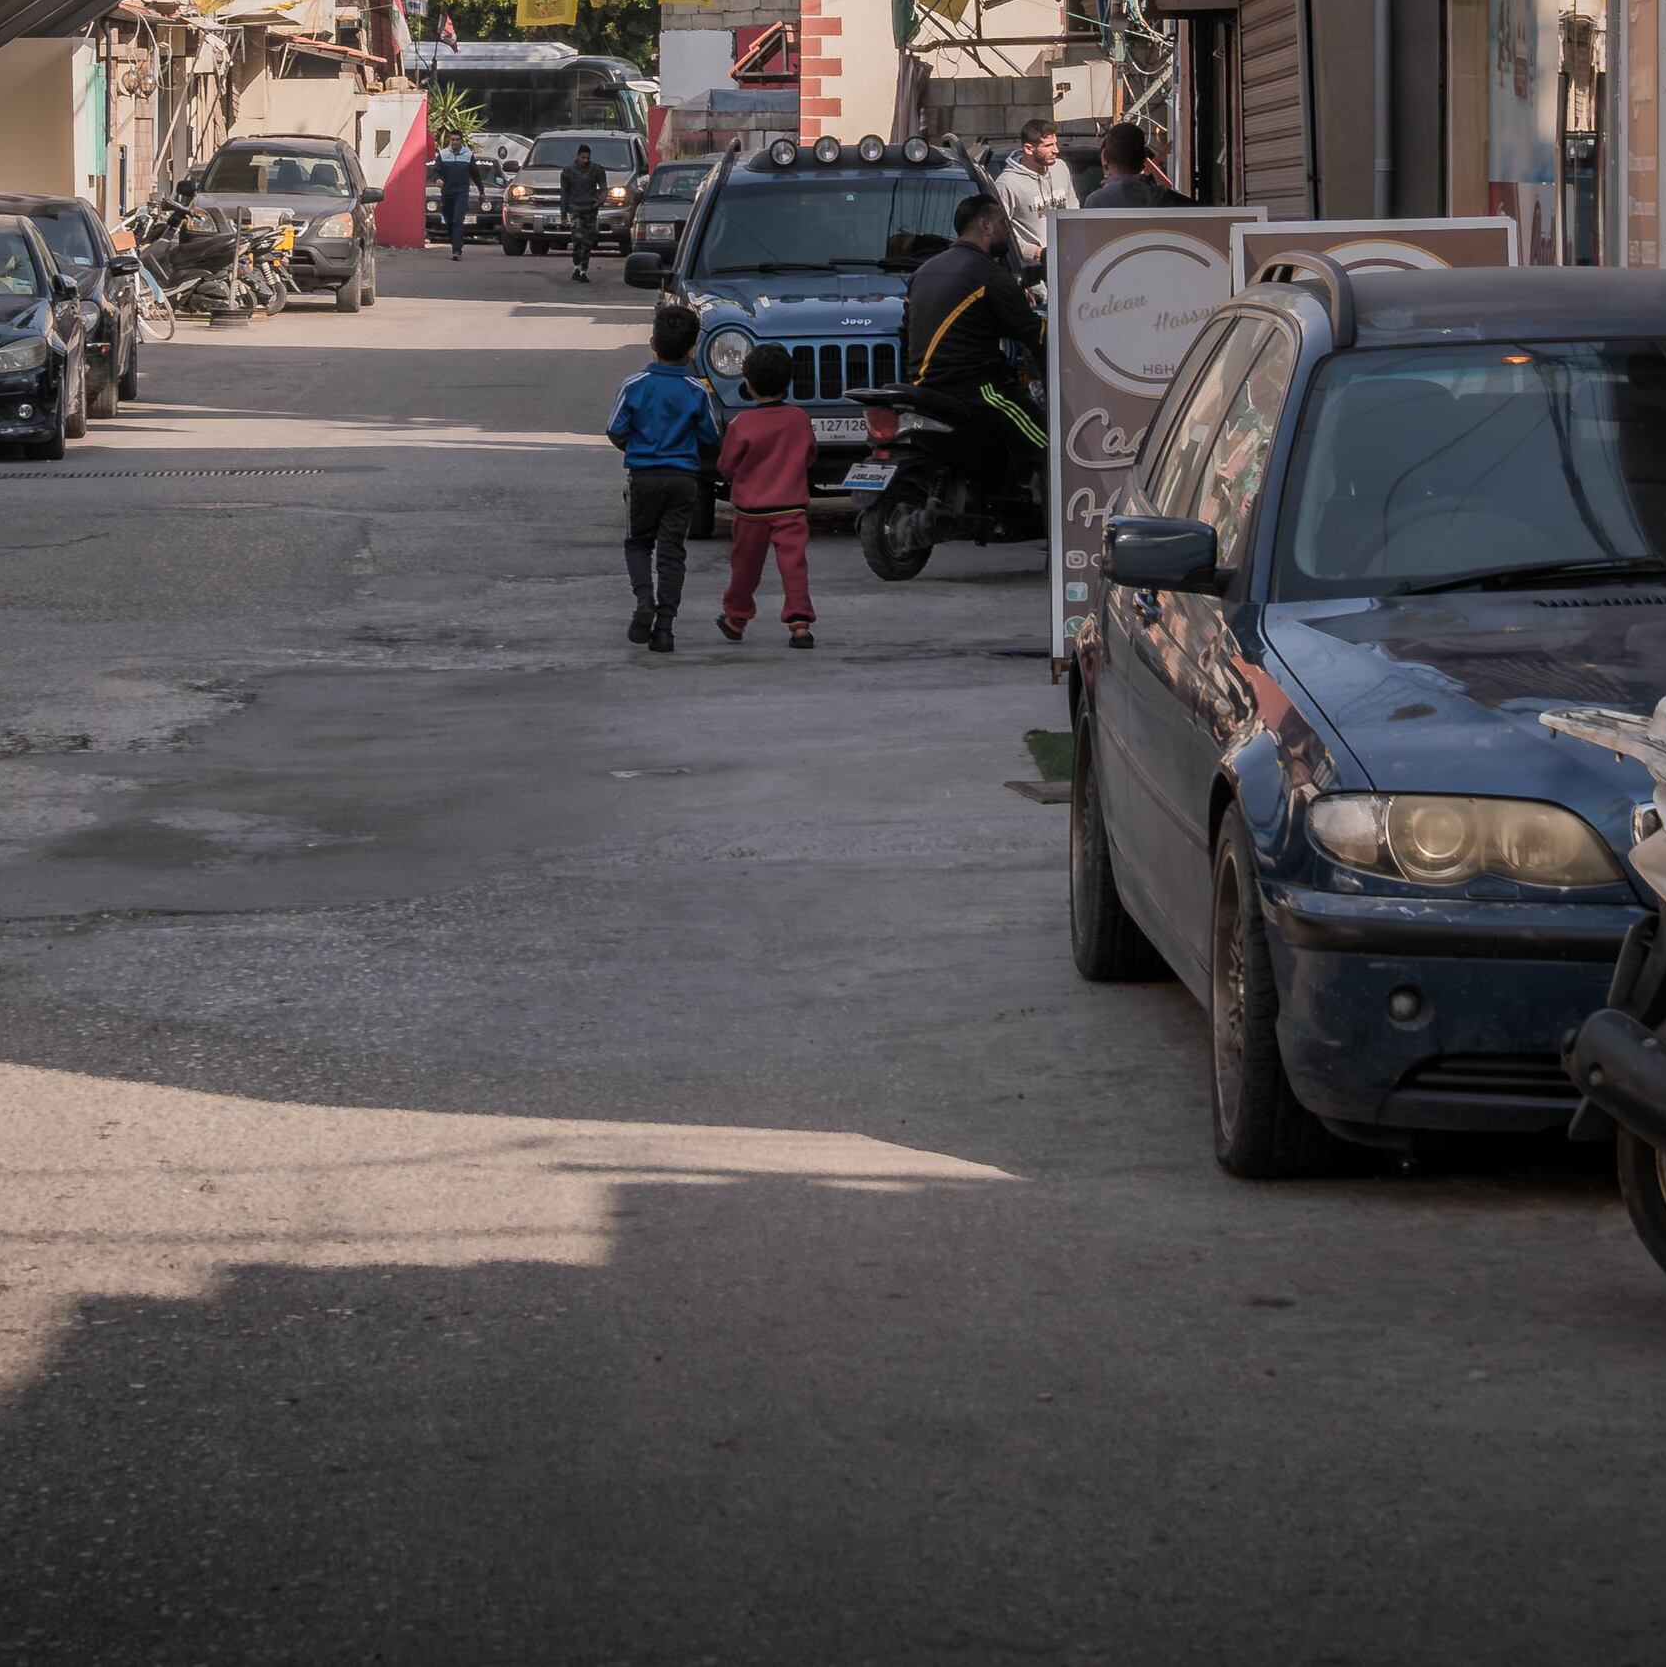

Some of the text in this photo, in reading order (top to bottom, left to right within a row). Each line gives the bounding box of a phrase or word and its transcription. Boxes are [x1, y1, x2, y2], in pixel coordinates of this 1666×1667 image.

[1077, 293, 1149, 323] Cadeau
[840, 318, 873, 327] Jeep
[1142, 363, 1176, 375] H&H
[820, 420, 867, 432] 127128
